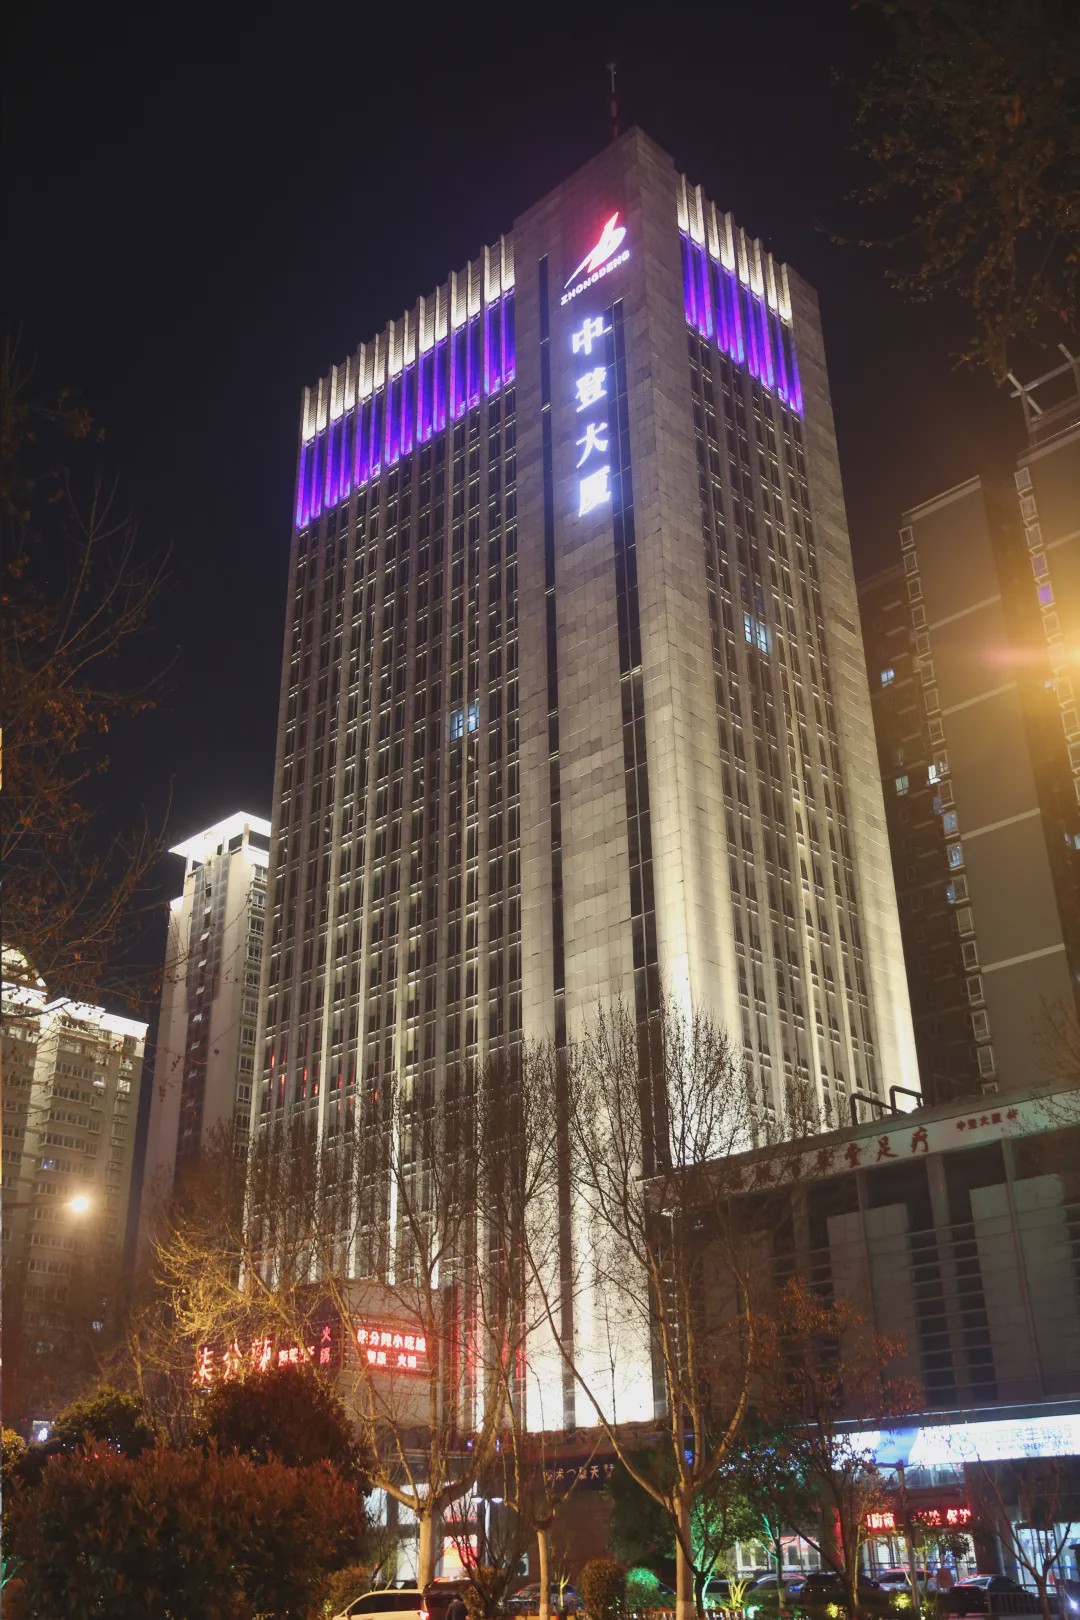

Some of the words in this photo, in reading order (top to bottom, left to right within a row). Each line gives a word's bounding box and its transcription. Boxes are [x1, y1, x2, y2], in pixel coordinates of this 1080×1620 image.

[560, 249, 630, 306] ZHONGDENG
[572, 316, 612, 517] 中登大厦
[320, 1326, 332, 1365] 火锅
[980, 1424, 1072, 1444] 中国民生银行
